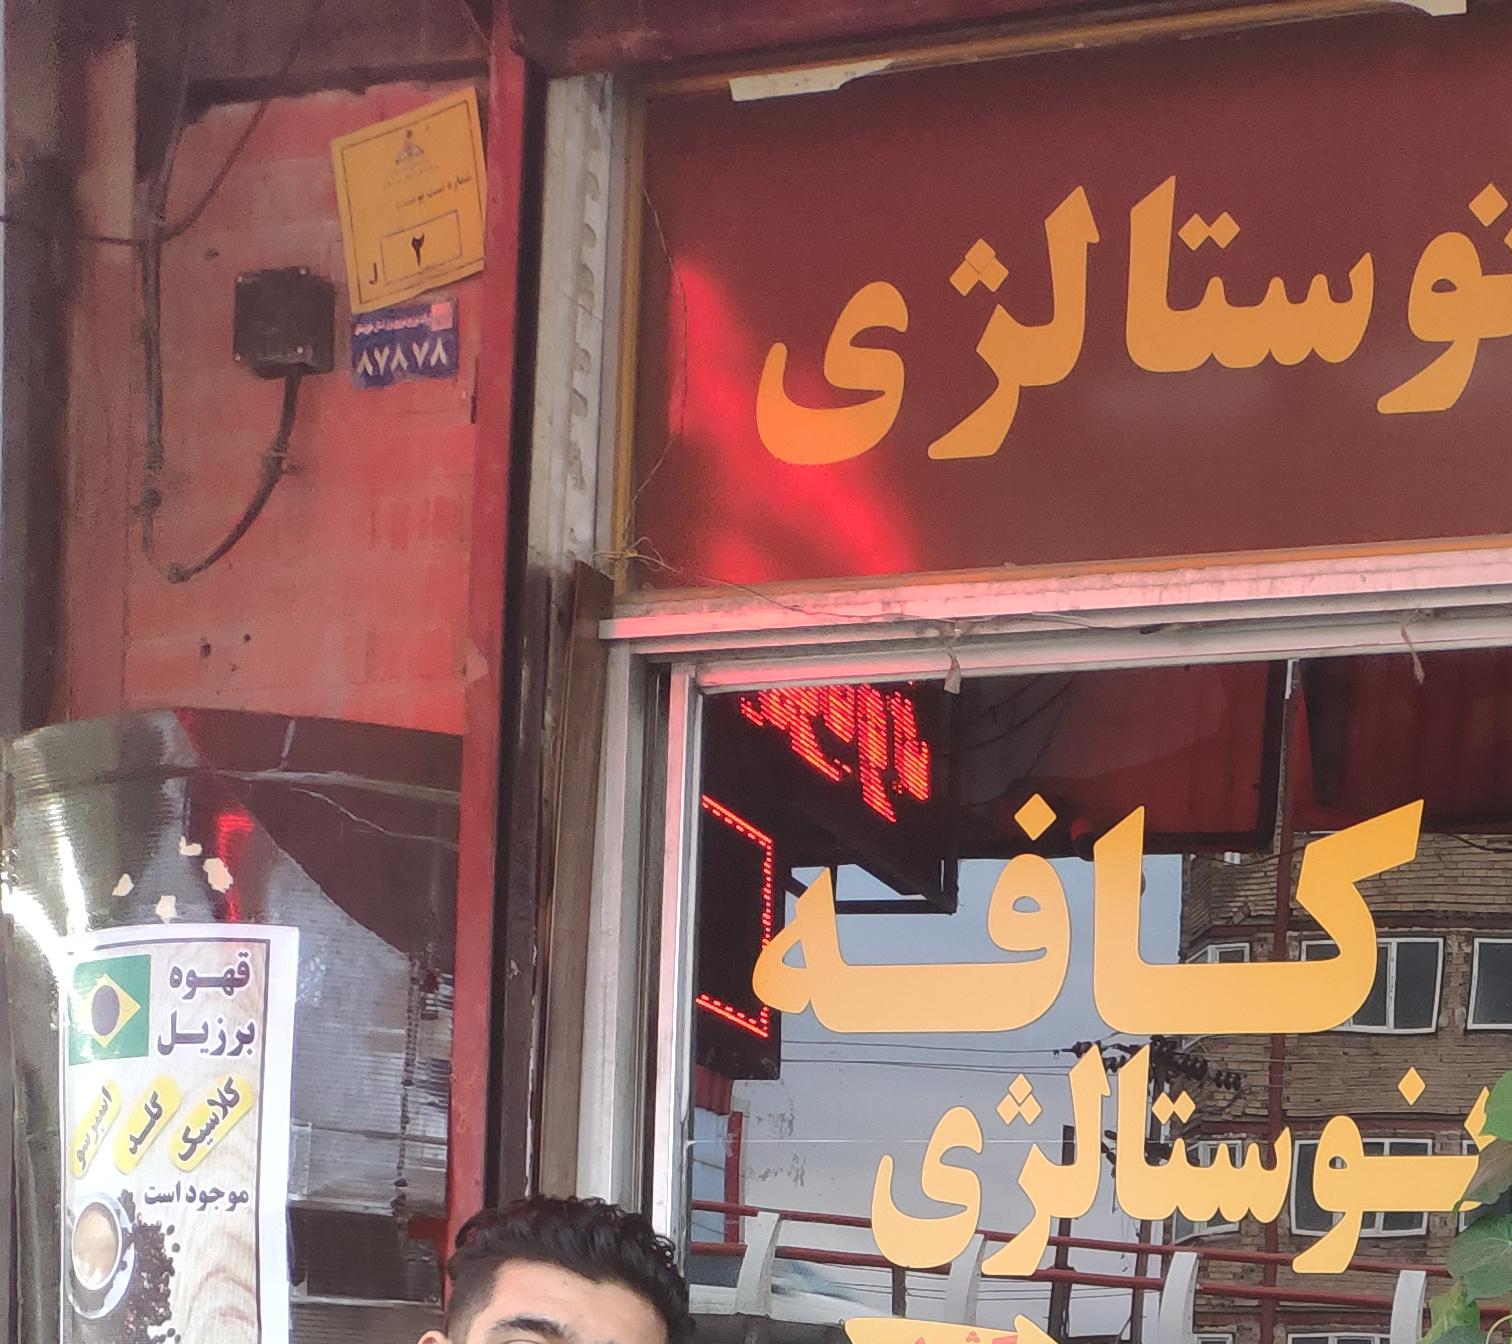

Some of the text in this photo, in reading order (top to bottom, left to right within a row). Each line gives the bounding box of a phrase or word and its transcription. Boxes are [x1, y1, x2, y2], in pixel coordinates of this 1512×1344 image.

[752, 793, 1424, 1036] کافه
[169, 950, 251, 1001] قهوه
[157, 1009, 256, 1057] برزیل
[178, 1075, 241, 1162] کلاسیک
[144, 1179, 250, 1212] موجود است
